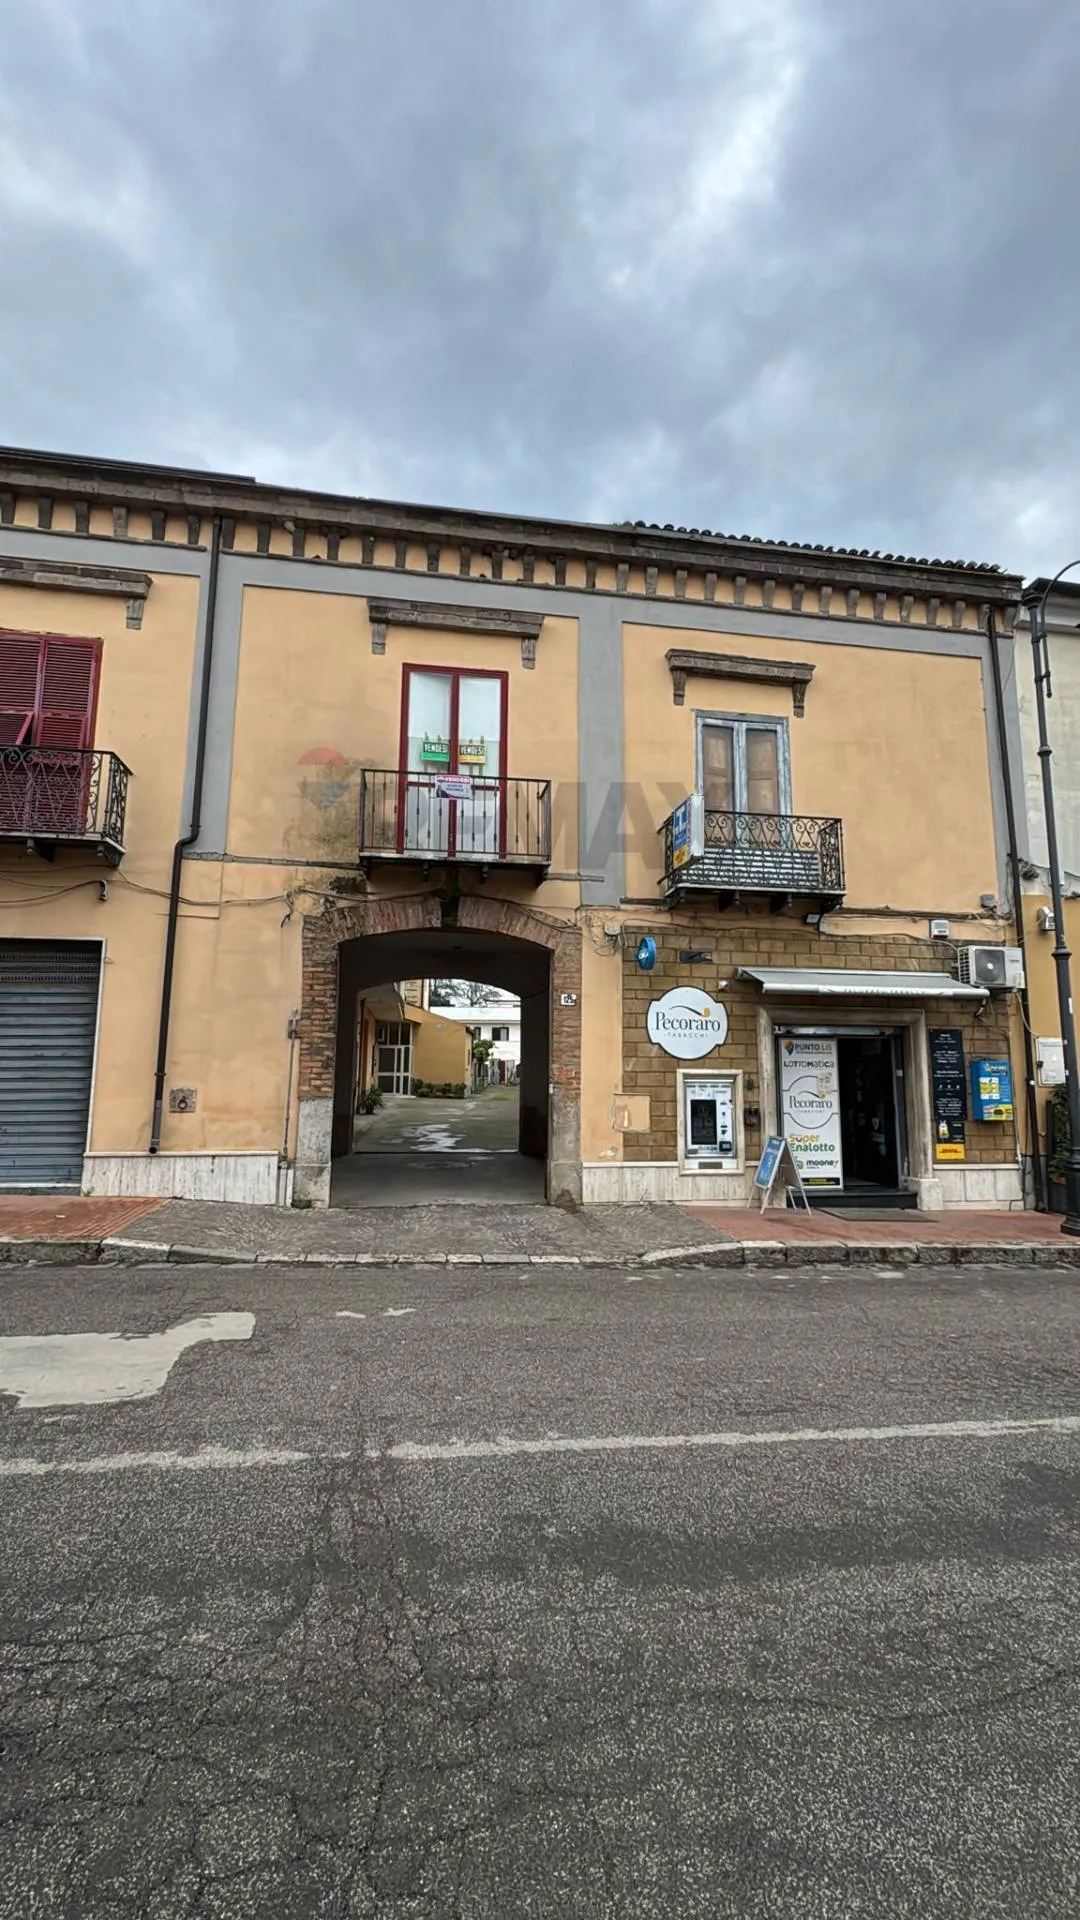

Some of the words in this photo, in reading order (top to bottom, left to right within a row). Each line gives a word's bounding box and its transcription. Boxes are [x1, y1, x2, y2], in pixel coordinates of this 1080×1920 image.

[424, 743, 449, 753] VENDESI
[460, 746, 485, 755] VENDESI
[655, 1011, 721, 1032] Pecoraro
[794, 1043, 820, 1051] PUNTO
[789, 1095, 833, 1108] Pecoraro
[788, 1133, 820, 1143] Super
[789, 1143, 835, 1152] Enalotto
